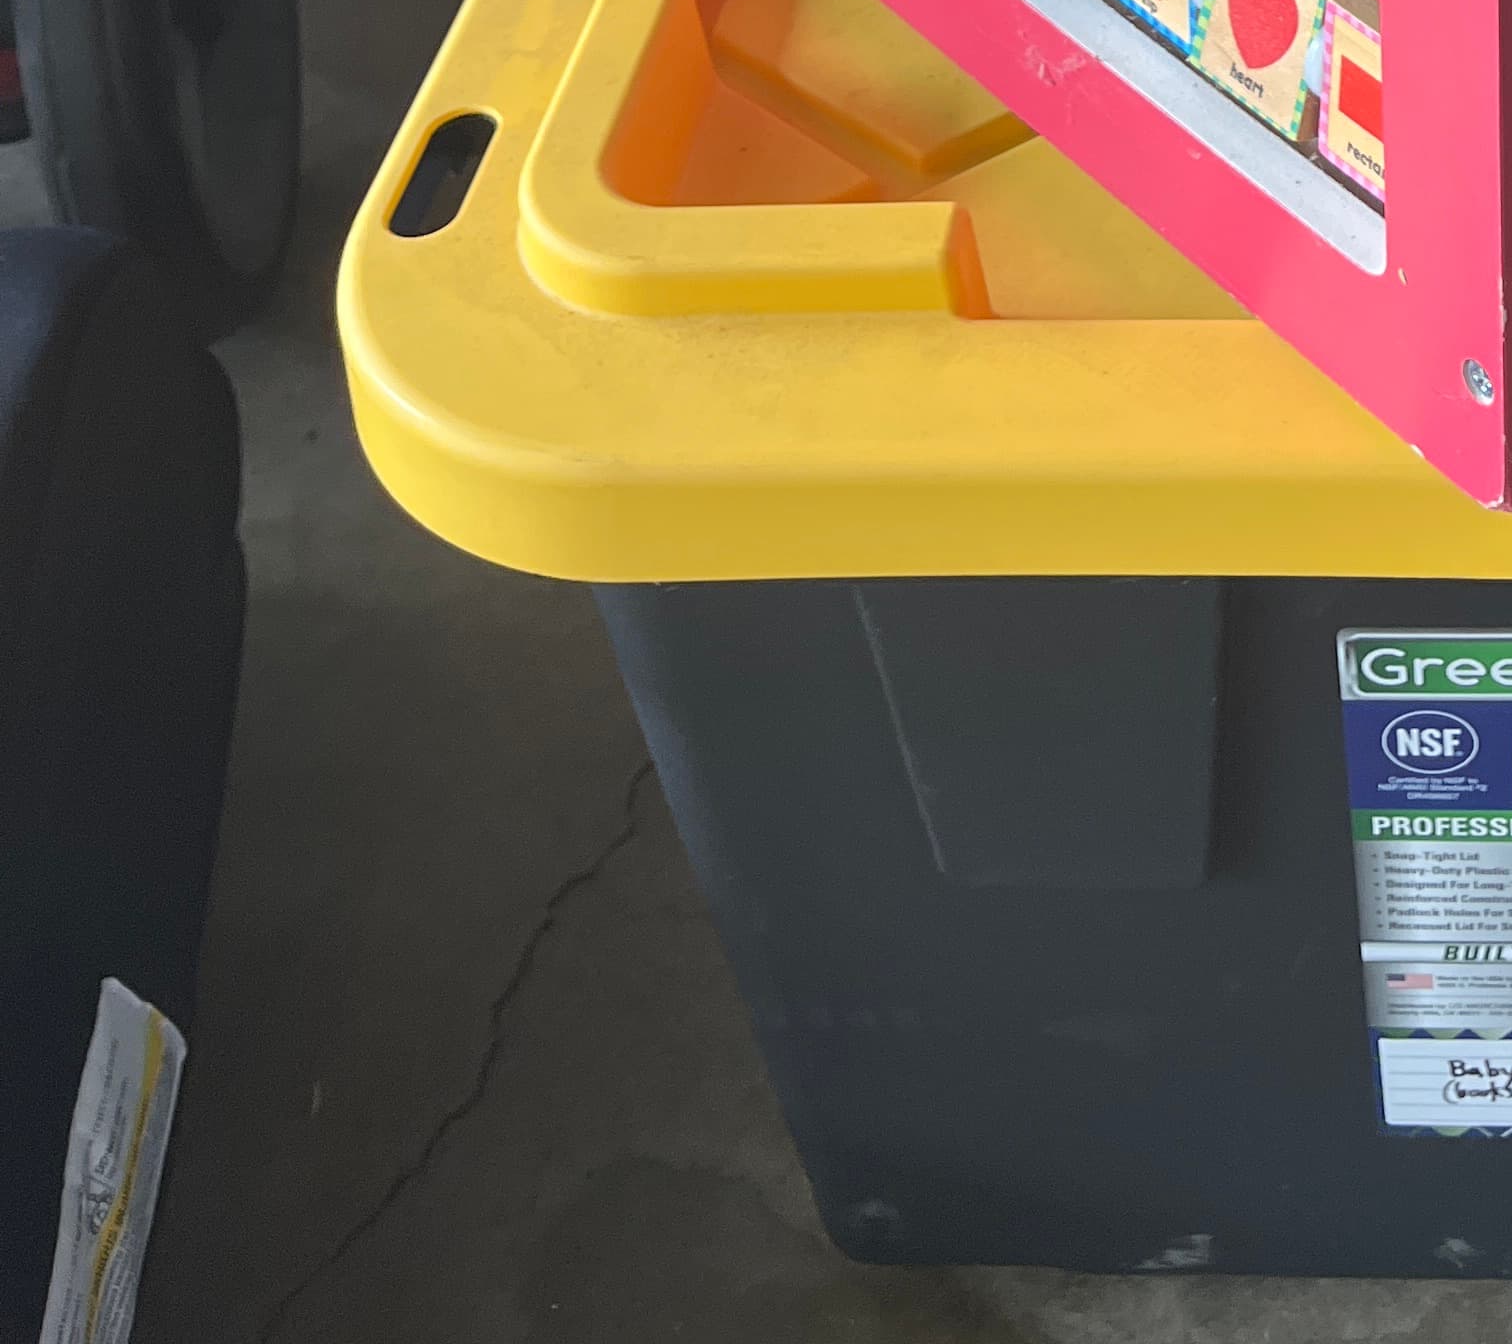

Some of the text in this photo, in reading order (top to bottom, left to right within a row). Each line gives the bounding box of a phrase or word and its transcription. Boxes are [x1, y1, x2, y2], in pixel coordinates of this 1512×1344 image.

[1229, 63, 1264, 98] heart
[1346, 139, 1384, 180] recta
[1395, 727, 1465, 758] NSF
[1385, 880, 1447, 890] Designed
[1449, 881, 1471, 889] For
[1465, 866, 1511, 876] Plastic
